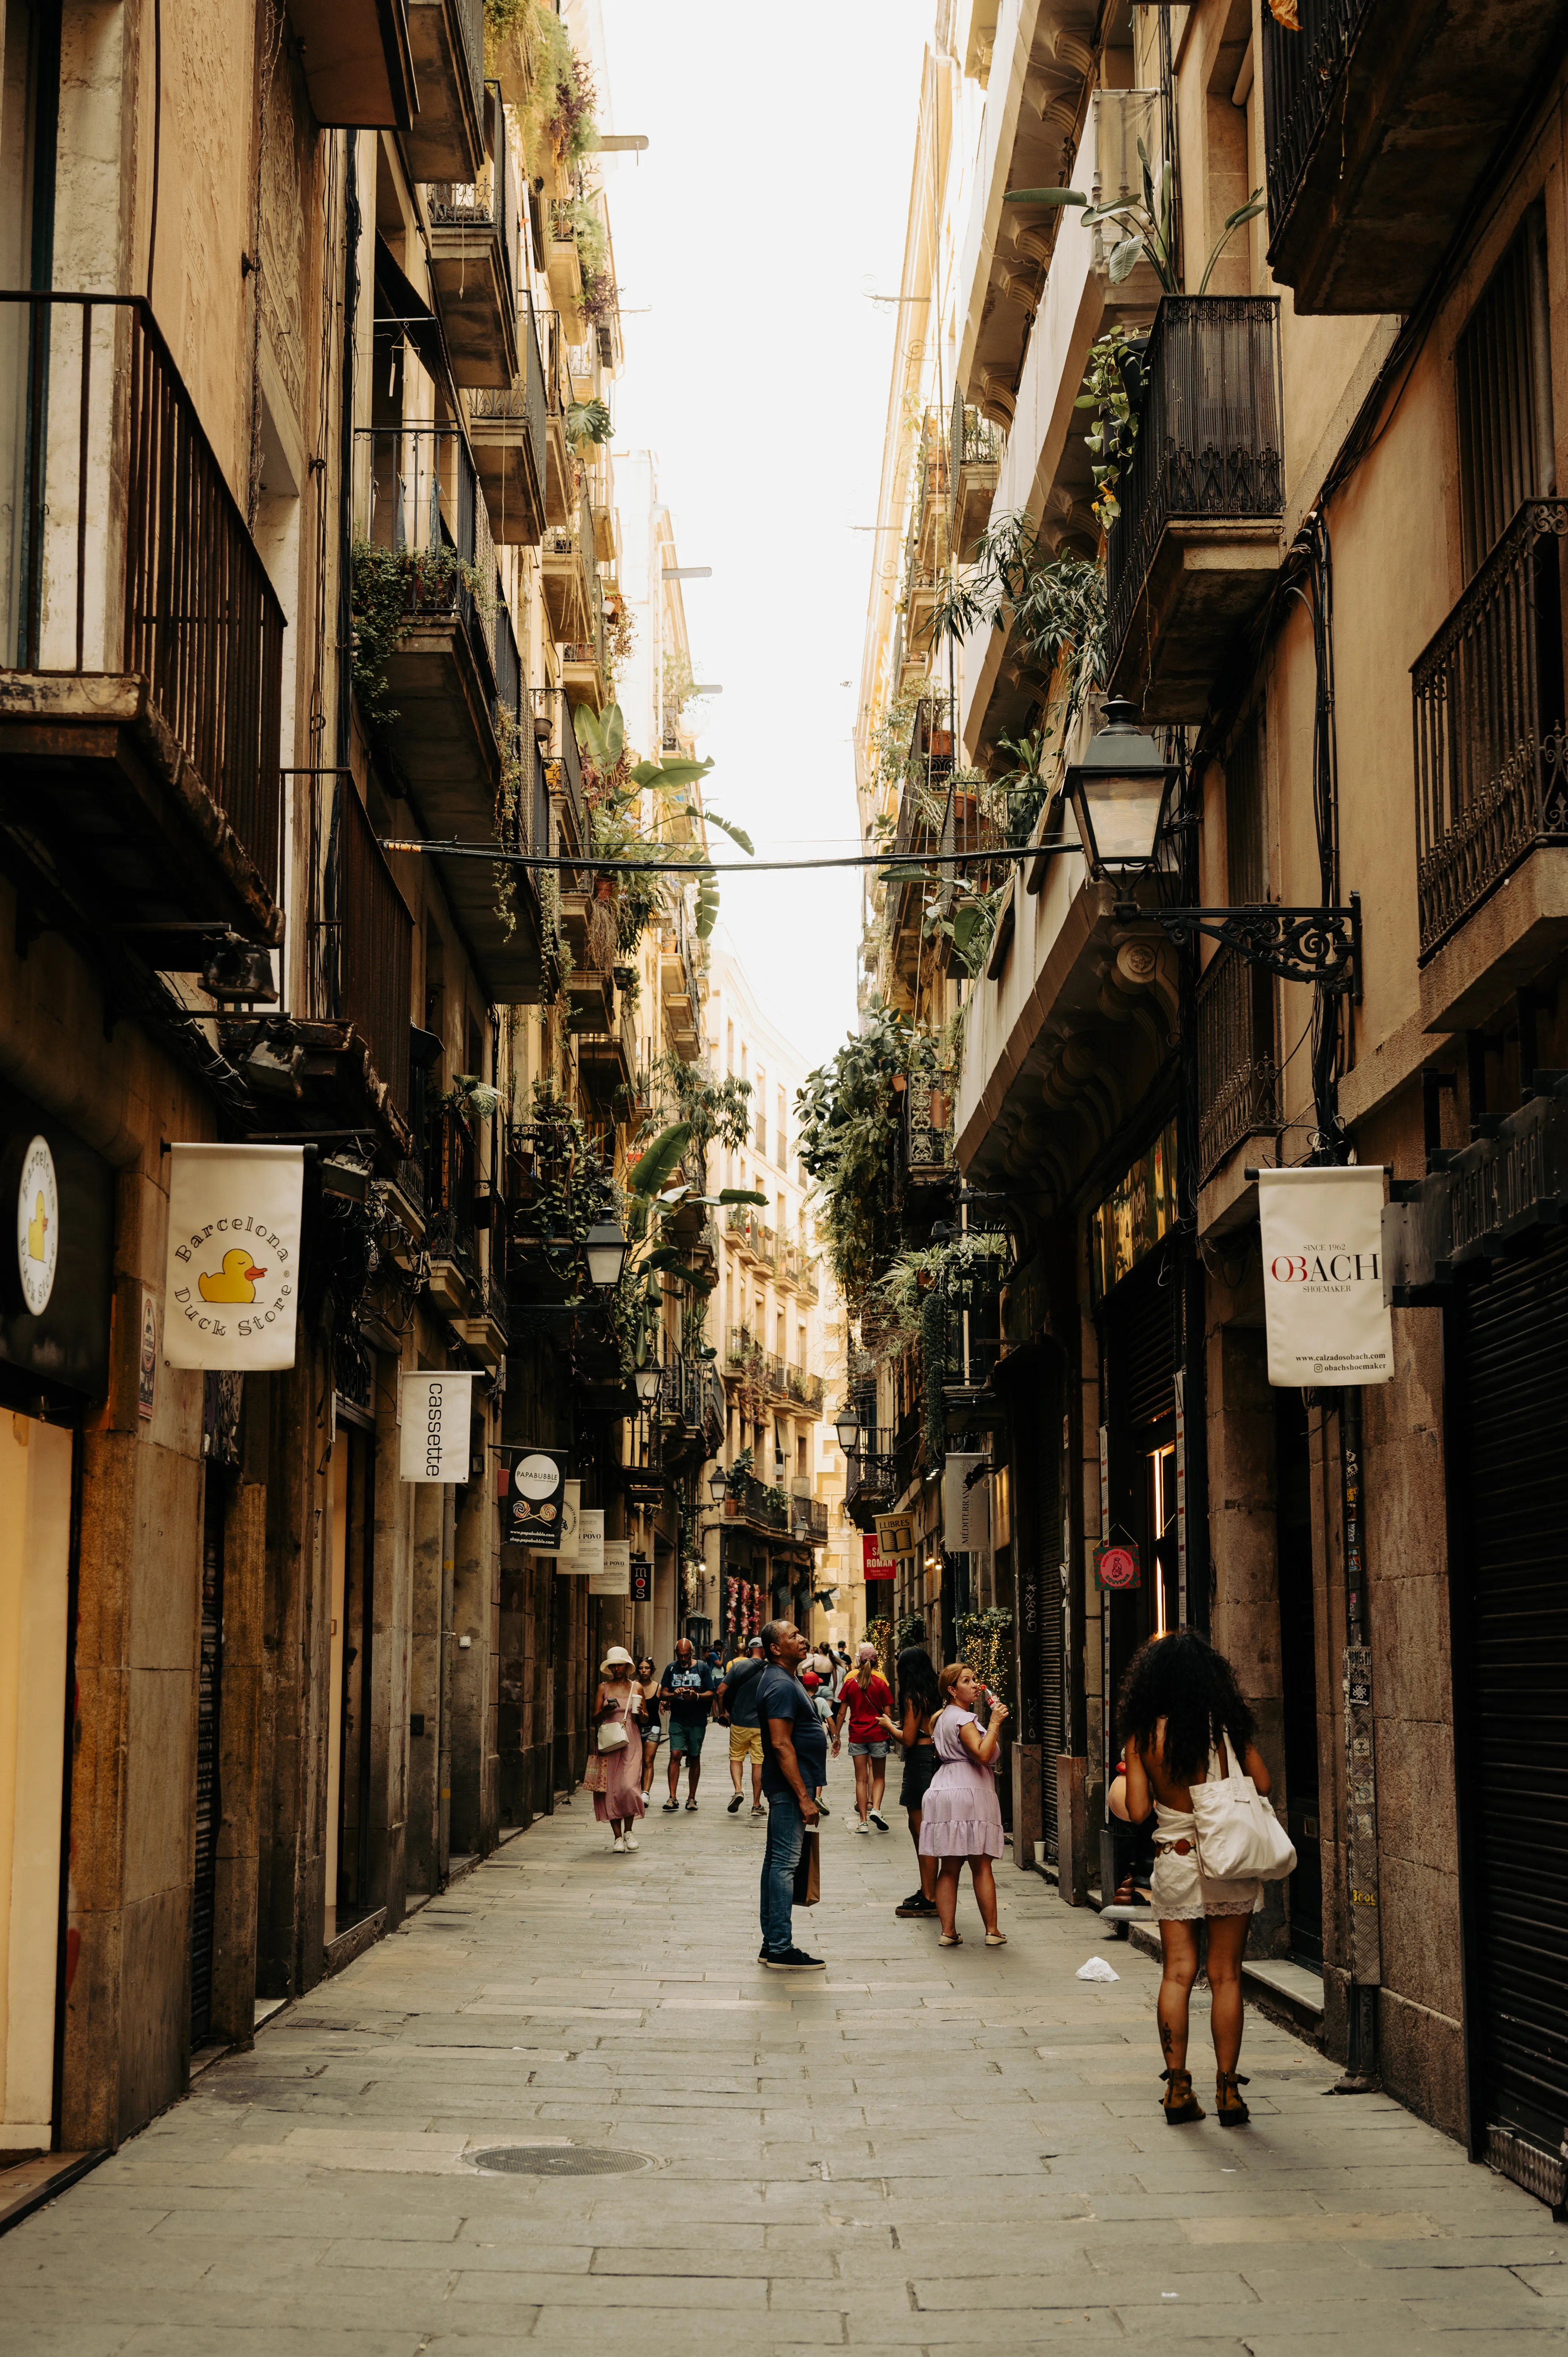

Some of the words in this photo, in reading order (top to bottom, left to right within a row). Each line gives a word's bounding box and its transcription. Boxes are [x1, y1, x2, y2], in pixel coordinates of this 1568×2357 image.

[175, 1216, 288, 1263] Barcelona
[1272, 1253, 1381, 1282] OBACH
[175, 1287, 227, 1336] Duck
[238, 1284, 291, 1336] Store
[1296, 1353, 1386, 1361] www.calzadosobach.com
[1325, 1363, 1386, 1371] obachshoemaker
[426, 1383, 442, 1476] cassette
[517, 1471, 558, 1480] PAPABUBBLE
[879, 1519, 910, 1529] LLIBRES
[867, 1559, 892, 1568] ROMAN
[1105, 1573, 1130, 1584] SOUVENIR
